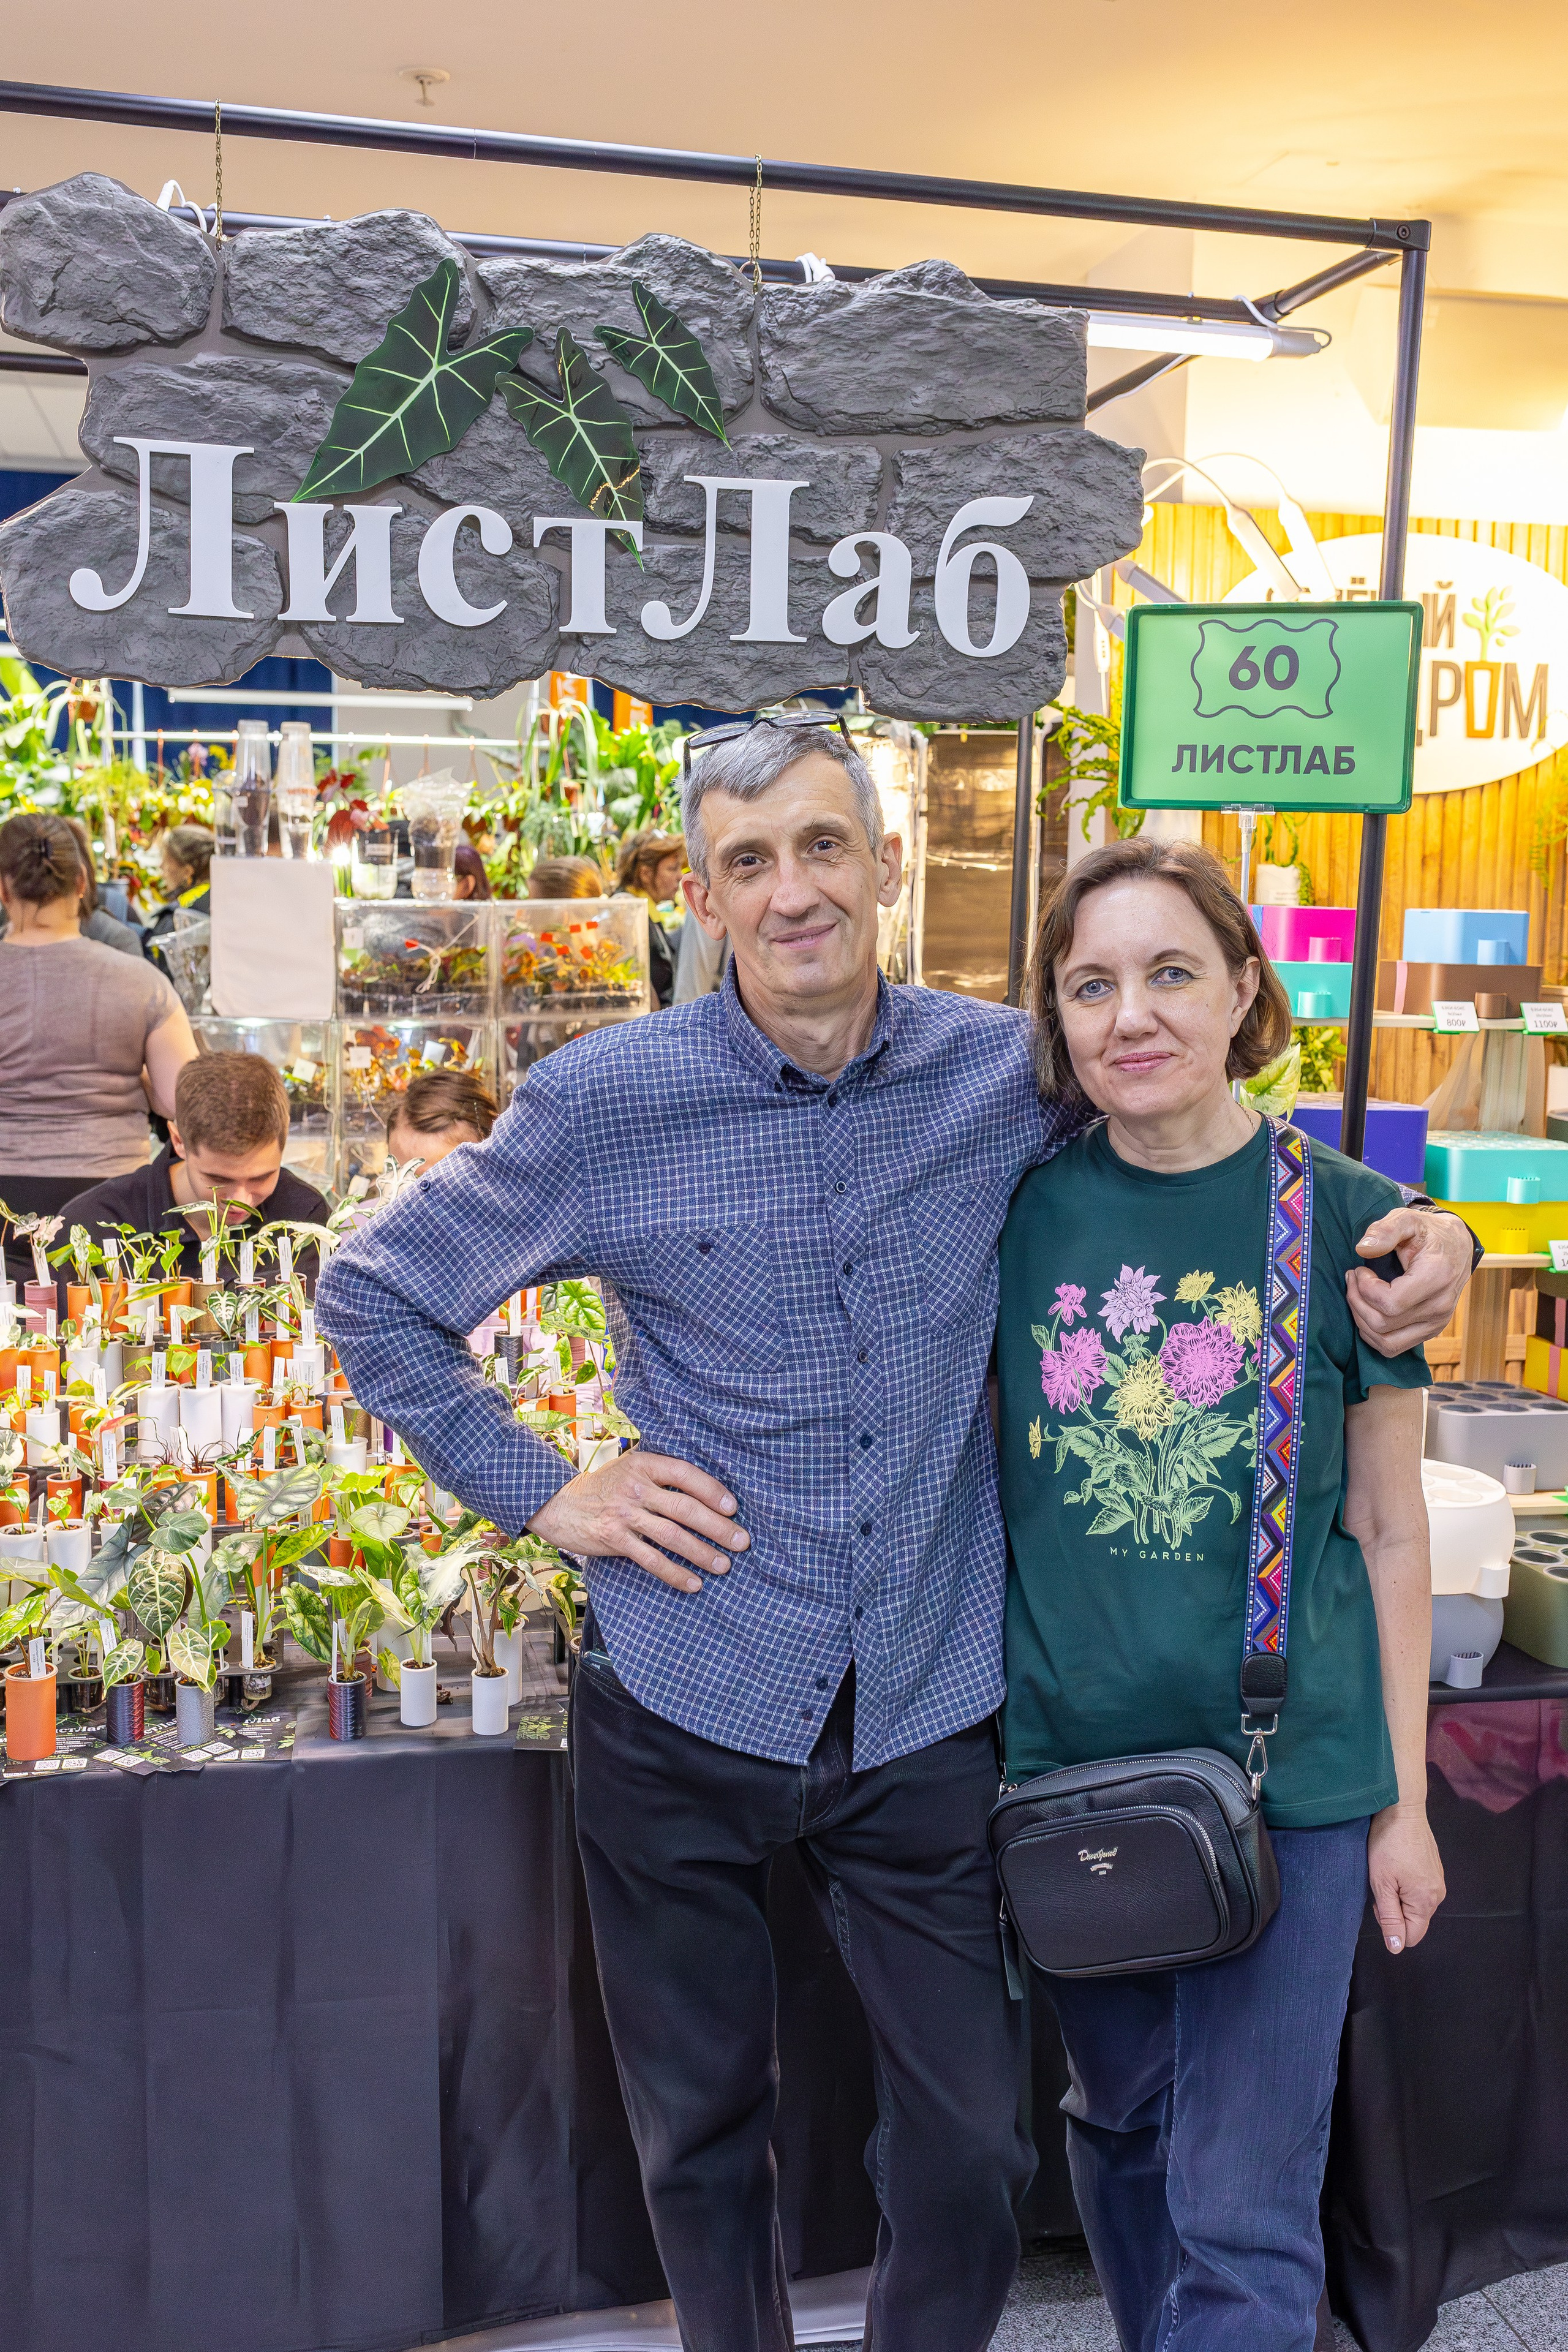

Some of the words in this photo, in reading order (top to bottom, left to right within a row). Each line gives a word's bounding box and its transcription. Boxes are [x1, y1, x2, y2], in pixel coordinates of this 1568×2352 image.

[69, 435, 1035, 658] ЛистЛаб
[1228, 644, 1300, 691] 60
[1171, 743, 1356, 775] ЛИСТЛАБ
[1110, 1547, 1128, 1557] MY
[1139, 1550, 1204, 1561] GARDEN
